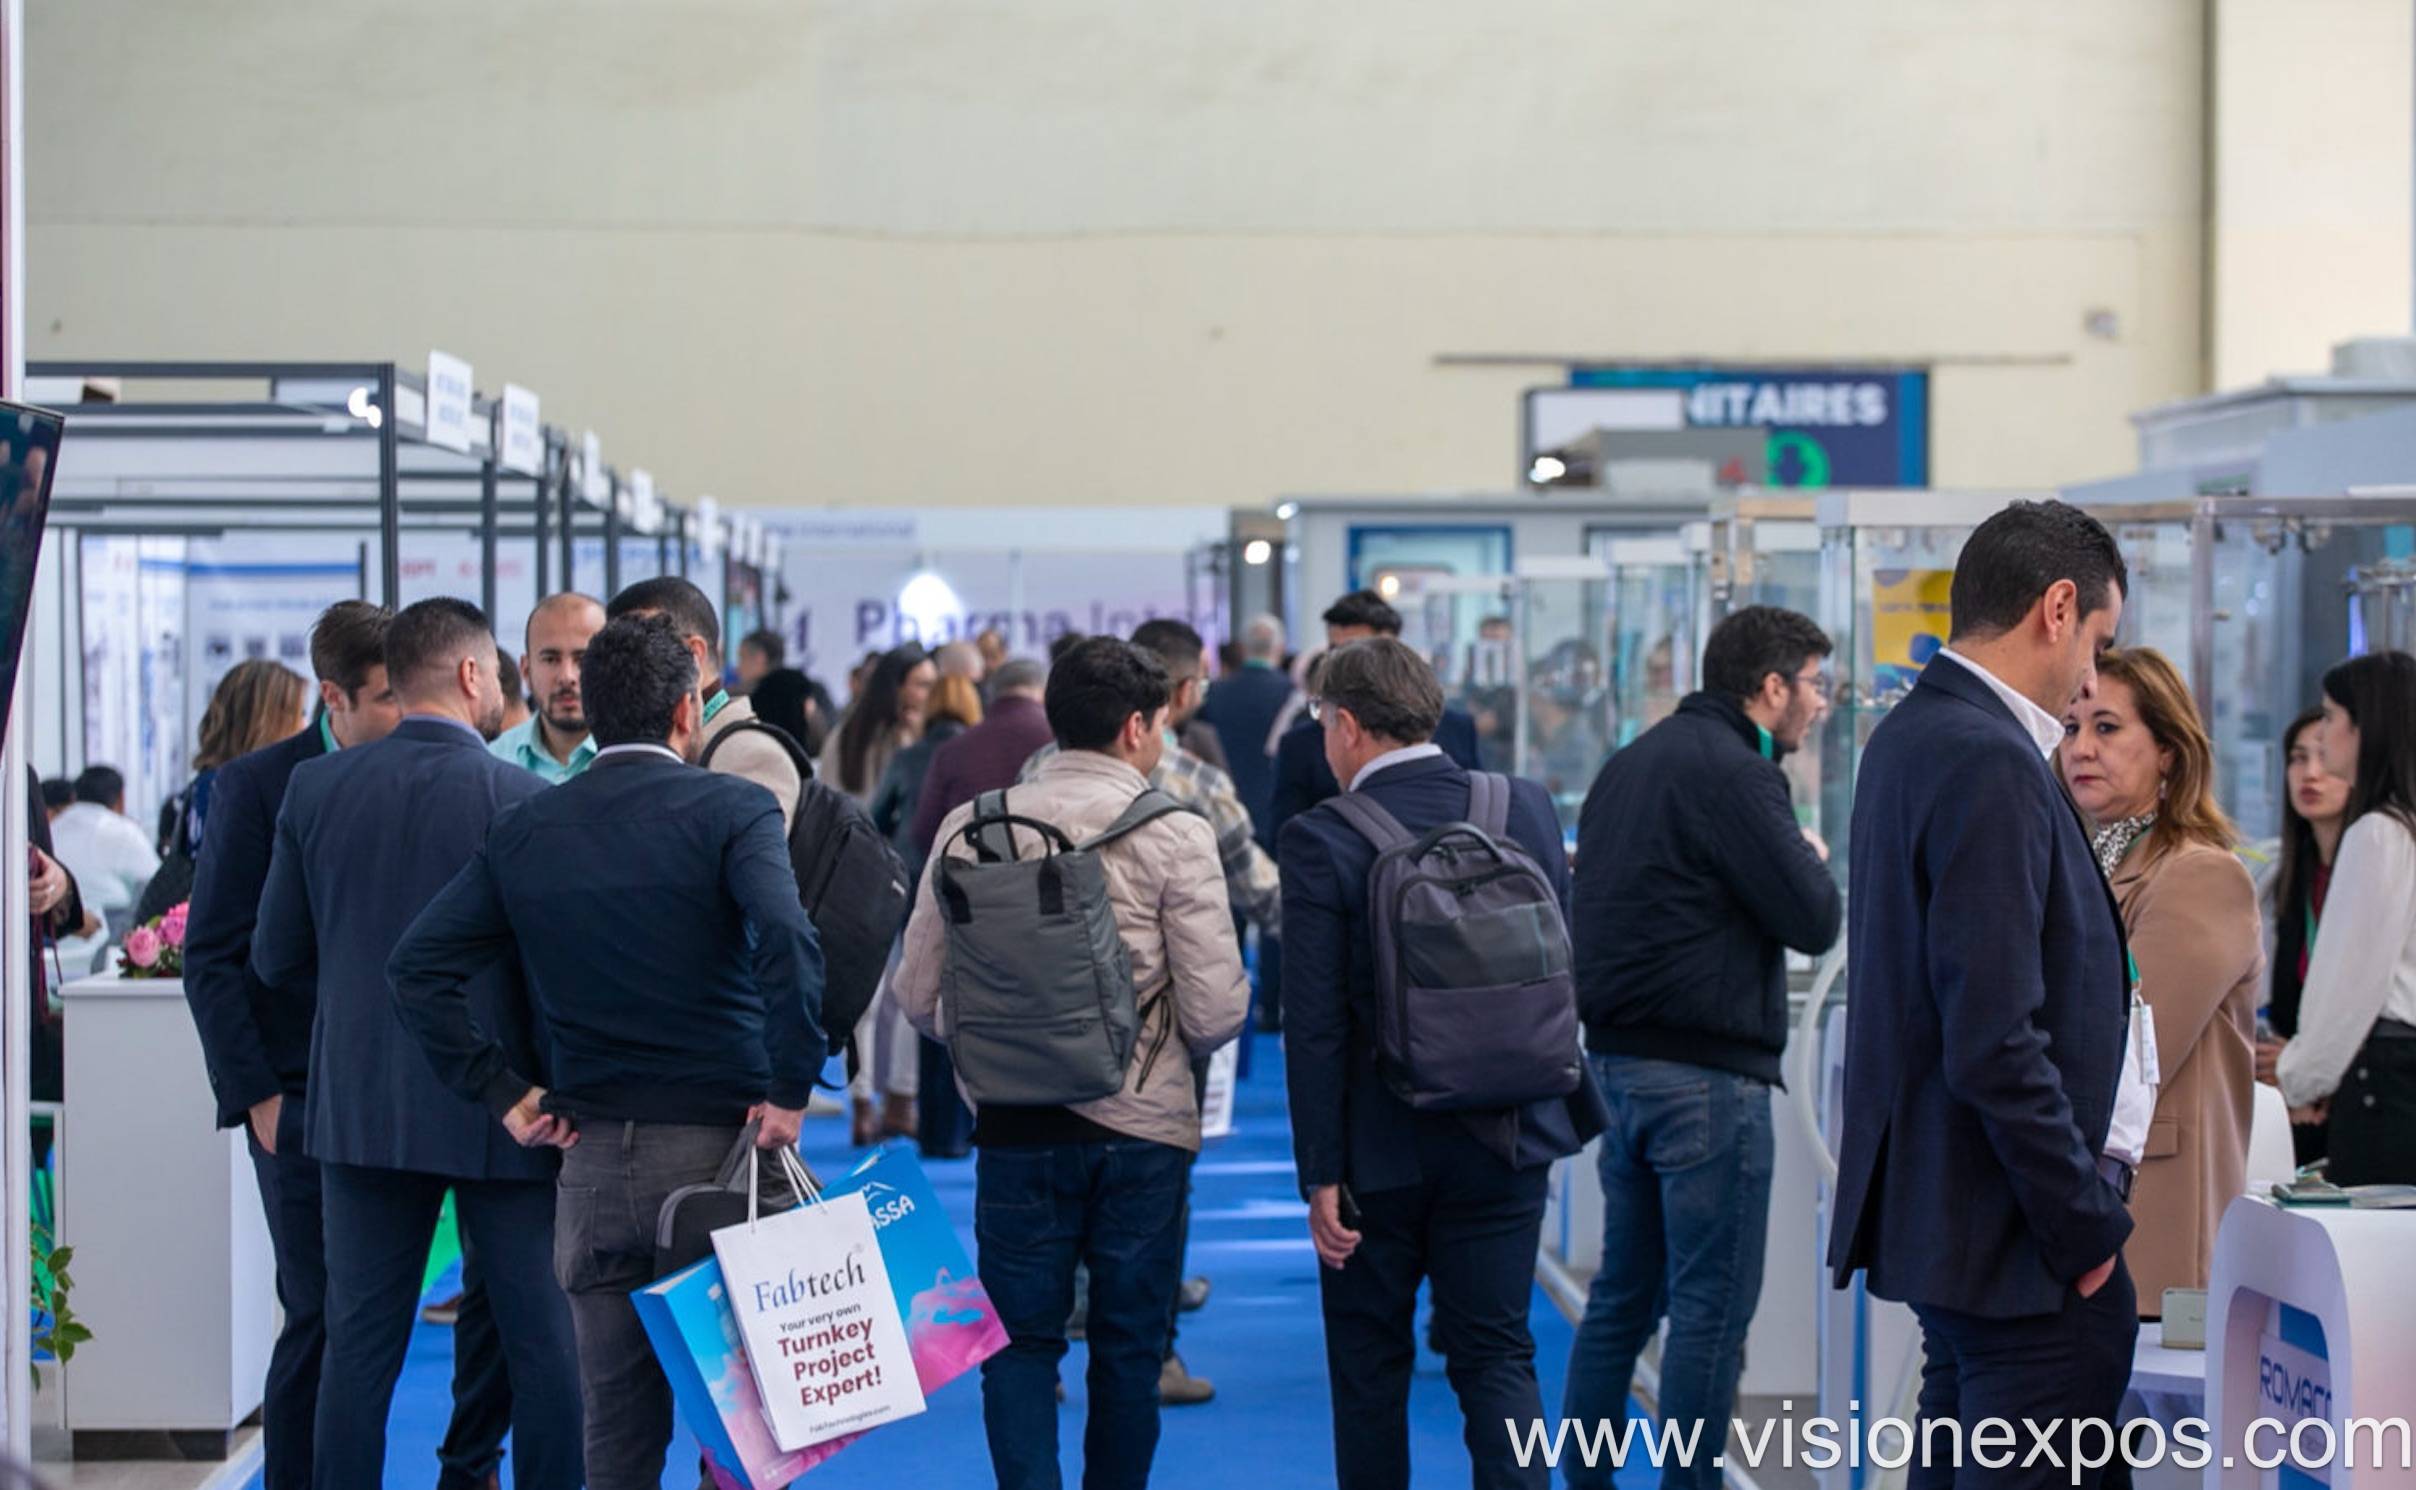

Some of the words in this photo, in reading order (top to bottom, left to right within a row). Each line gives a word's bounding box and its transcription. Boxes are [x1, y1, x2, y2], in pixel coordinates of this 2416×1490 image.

[754, 1251, 865, 1313] Fabtech
[777, 1317, 873, 1358] Turnkey
[780, 1318, 806, 1333] Your
[808, 1310, 835, 1326] very
[836, 1303, 861, 1317] own
[793, 1341, 875, 1381] Project
[800, 1364, 882, 1406] Expert!
